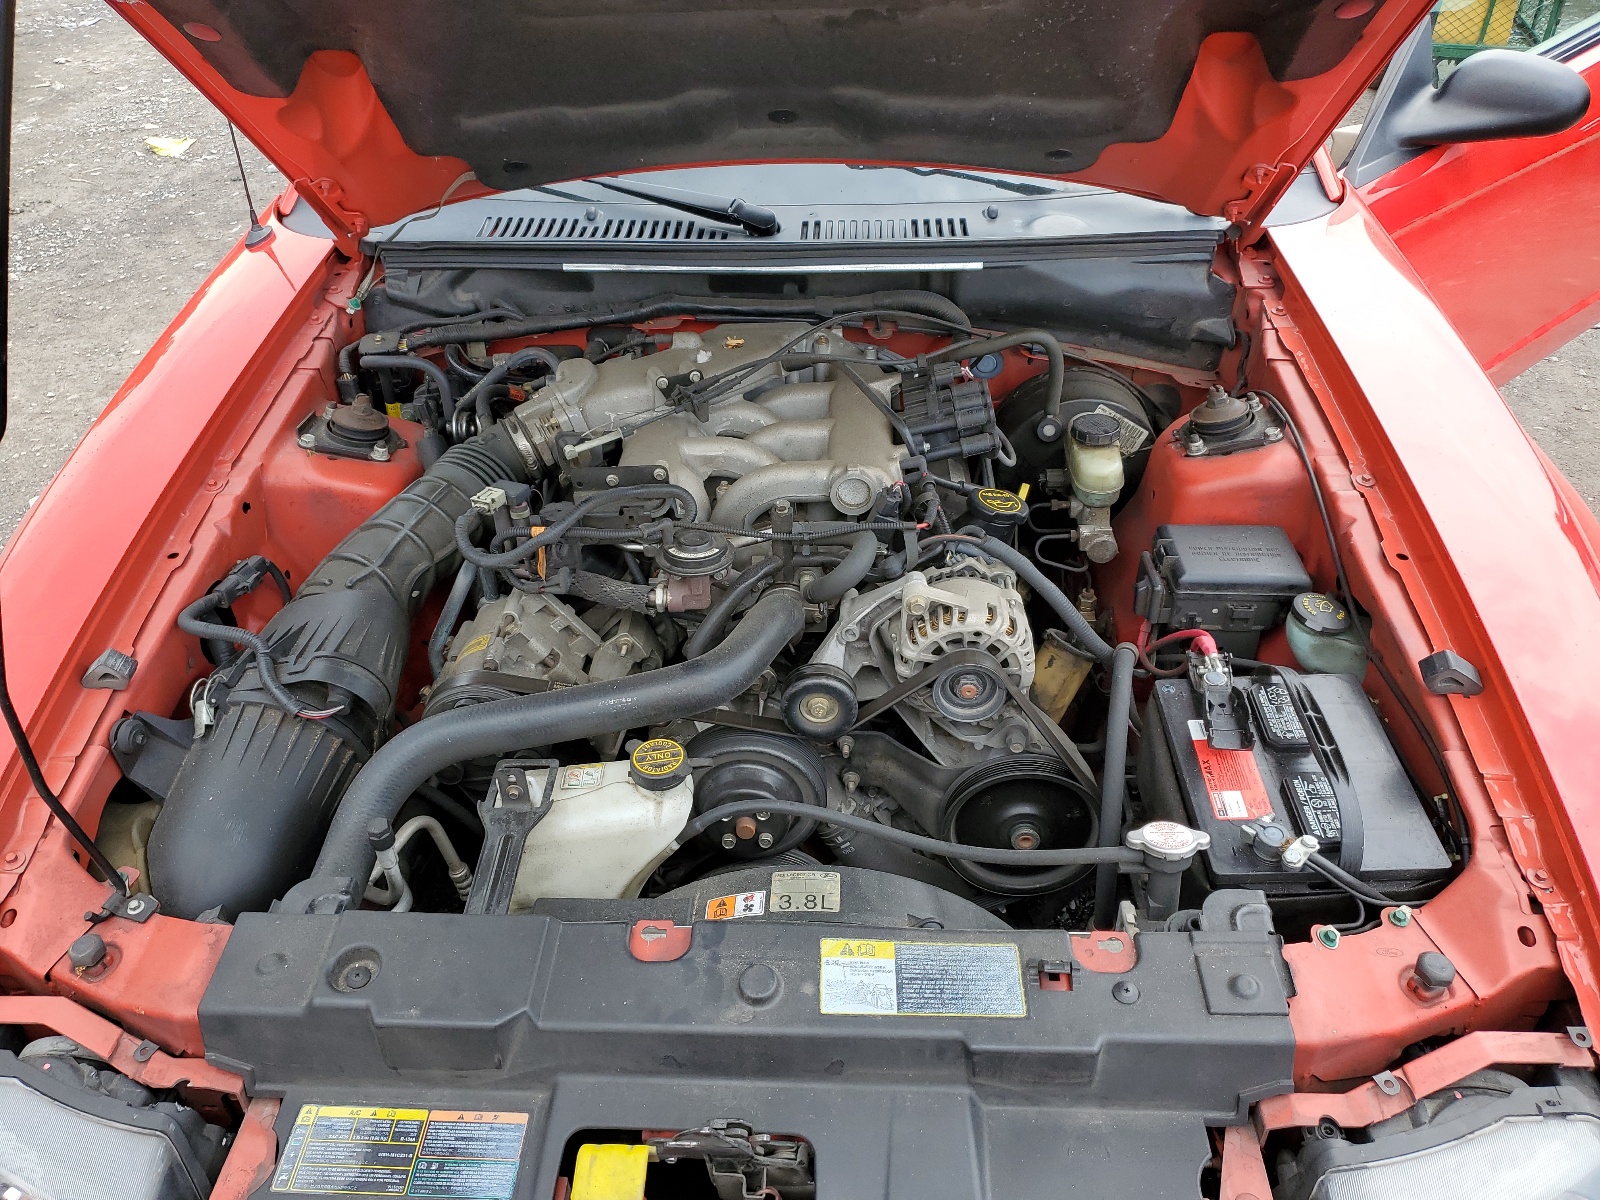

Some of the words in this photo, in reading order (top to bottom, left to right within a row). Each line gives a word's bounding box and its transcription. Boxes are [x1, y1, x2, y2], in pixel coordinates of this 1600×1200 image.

[641, 741, 672, 751] COOLANT
[645, 752, 671, 761] ONLY
[642, 761, 678, 772] RADIATOR
[779, 894, 834, 910] 3.8L
